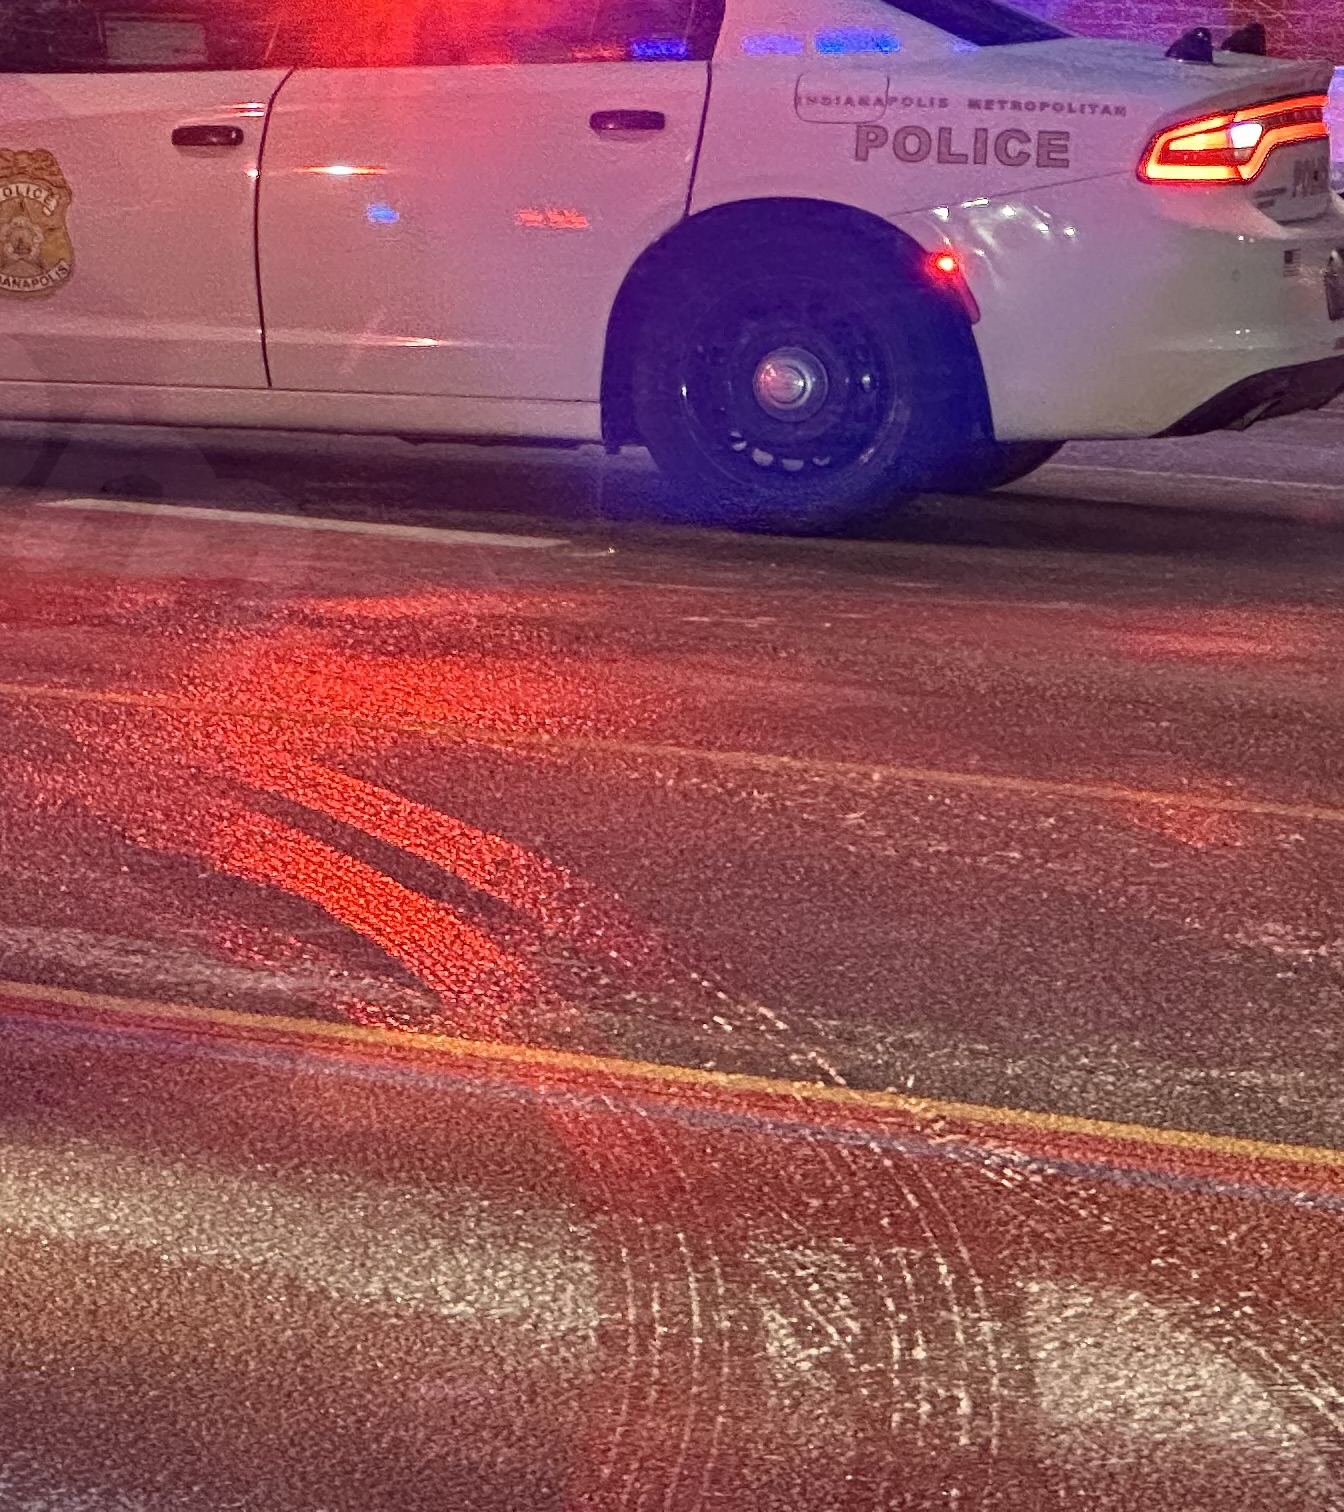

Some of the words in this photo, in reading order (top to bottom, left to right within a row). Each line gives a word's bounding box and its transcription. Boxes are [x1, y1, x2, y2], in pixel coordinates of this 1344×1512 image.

[794, 94, 950, 110] INDIANAPOLIS
[967, 97, 1128, 118] METROPOLITAN
[854, 123, 1071, 169] POLICE
